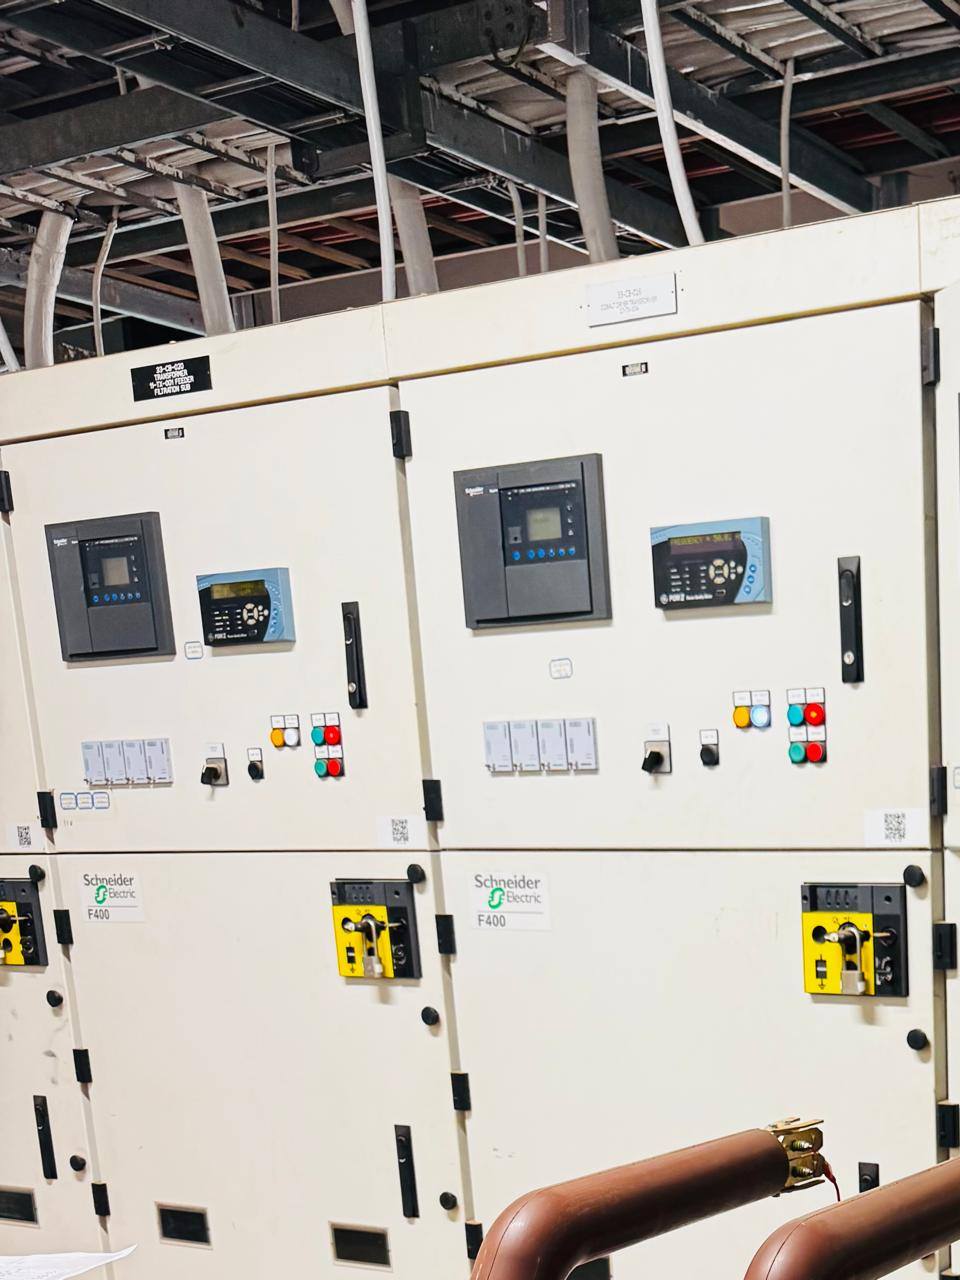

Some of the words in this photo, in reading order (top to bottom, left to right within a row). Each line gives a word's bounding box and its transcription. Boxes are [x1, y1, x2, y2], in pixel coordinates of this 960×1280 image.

[83, 873, 135, 887] Schneider
[474, 874, 541, 889] Schneider
[108, 887, 136, 899] Electric
[506, 890, 542, 904] Electric
[87, 908, 110, 920] F400
[477, 914, 506, 928] F400
